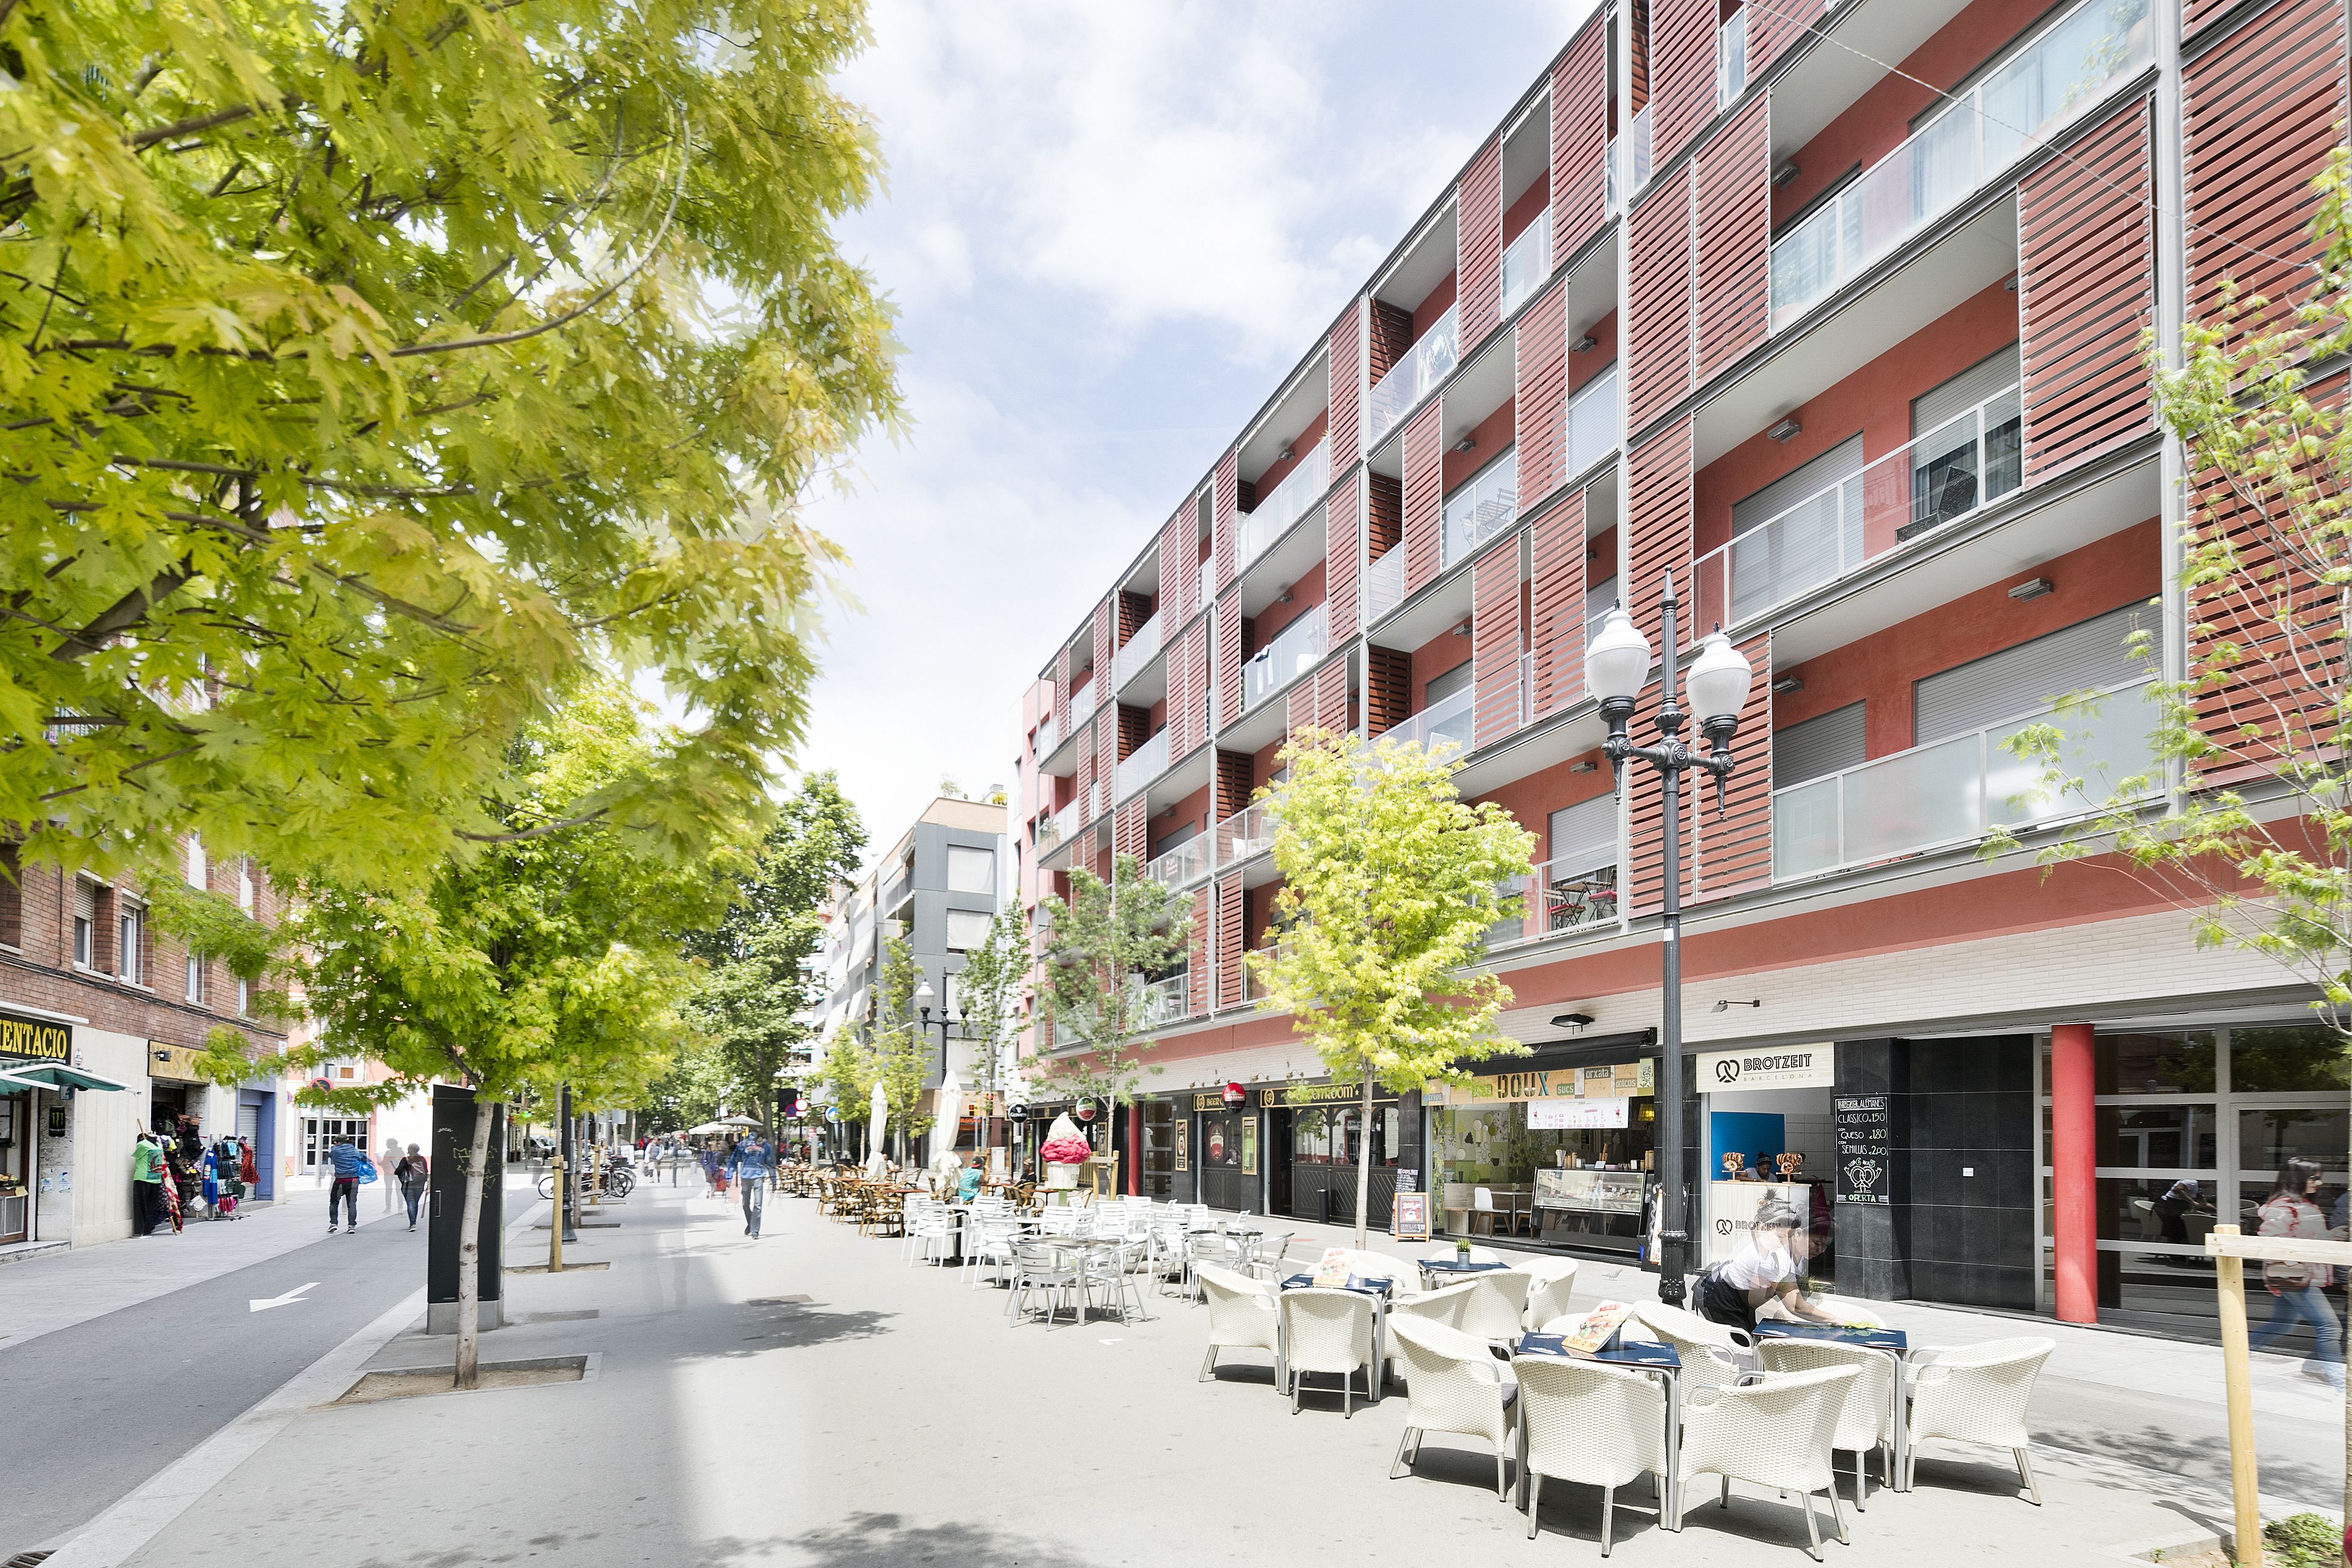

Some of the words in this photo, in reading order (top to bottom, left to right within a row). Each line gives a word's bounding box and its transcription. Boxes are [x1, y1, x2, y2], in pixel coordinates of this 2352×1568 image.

[0, 1019, 67, 1059] ENTACIO
[1744, 1054, 1812, 1071] BROTZEIT
[1586, 1068, 1609, 1079] orxata
[1744, 1073, 1812, 1082] BARCELONA
[1498, 1071, 1549, 1098] DOUX
[1558, 1085, 1574, 1094] sucs
[1860, 1099, 1885, 1108] ALEMANES
[1838, 1113, 1869, 1123] CLASSICO
[1841, 1131, 1864, 1140] QUESO
[1842, 1145, 1868, 1155] SEMILLAS
[1849, 1194, 1876, 1202] OFERTA
